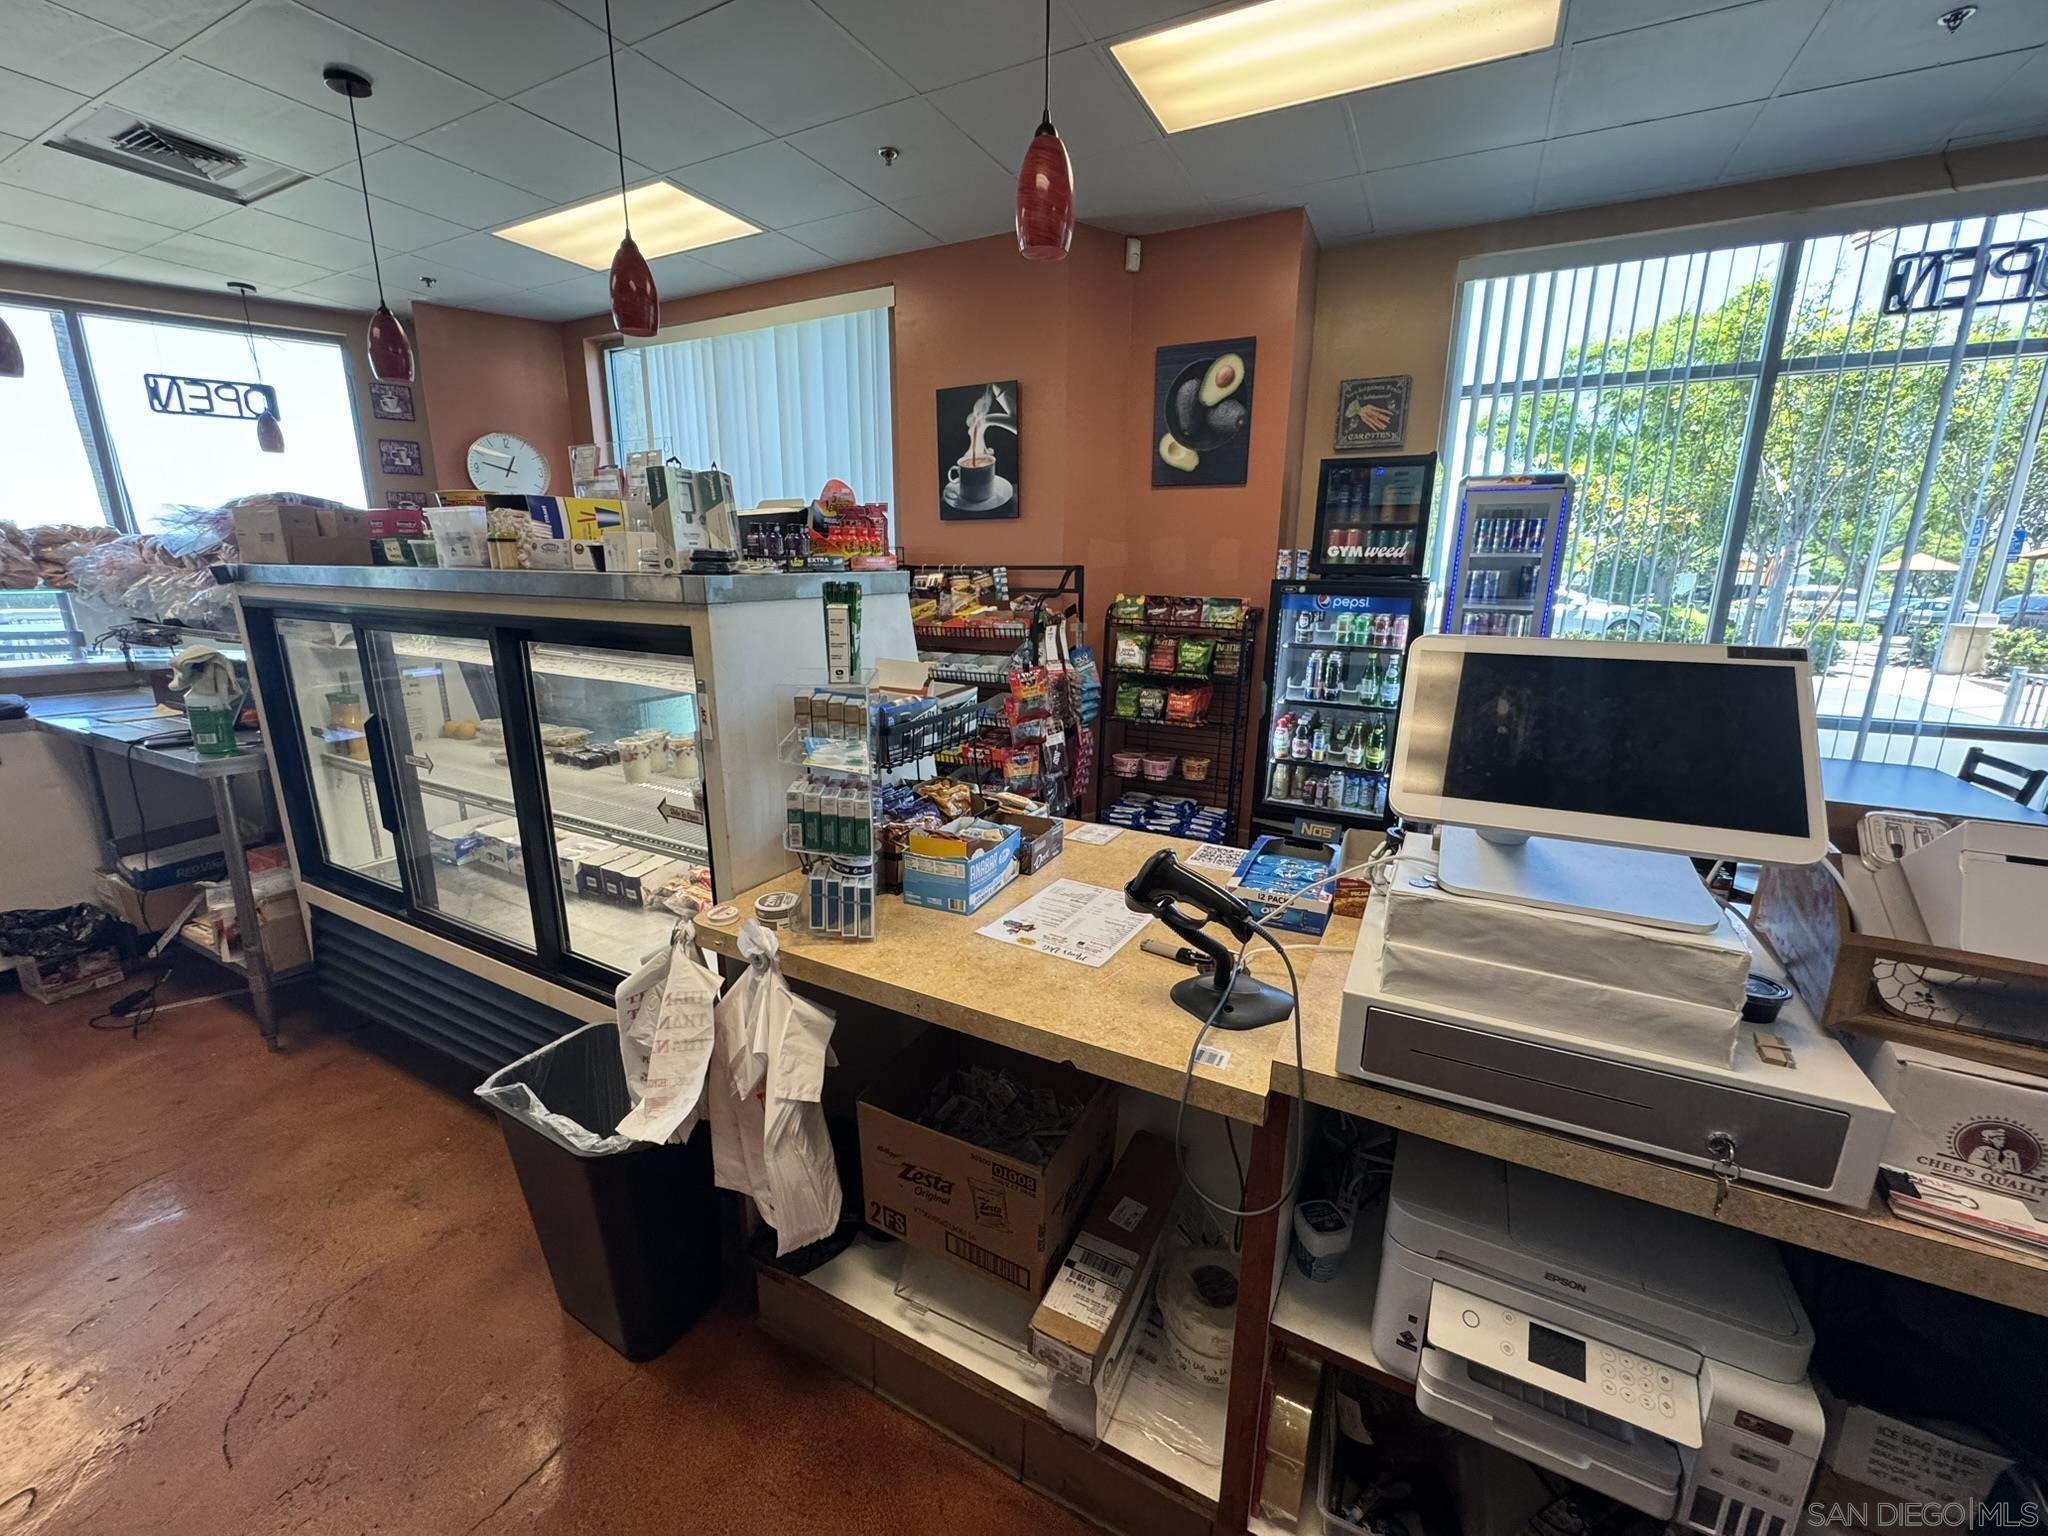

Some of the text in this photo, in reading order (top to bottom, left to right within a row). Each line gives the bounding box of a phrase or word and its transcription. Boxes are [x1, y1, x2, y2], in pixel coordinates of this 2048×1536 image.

[1327, 541, 1410, 558] GYM weed
[1332, 596, 1370, 609] pepsi
[1301, 822, 1336, 839] NOS
[1258, 893, 1266, 901] 12
[1916, 1155, 1976, 1178] CHEF'S
[897, 1161, 955, 1195] Zesta
[993, 1165, 1036, 1191] 01008
[913, 1185, 951, 1206] Original
[870, 1201, 882, 1225] 2
[1544, 1271, 1587, 1293] EPSON
